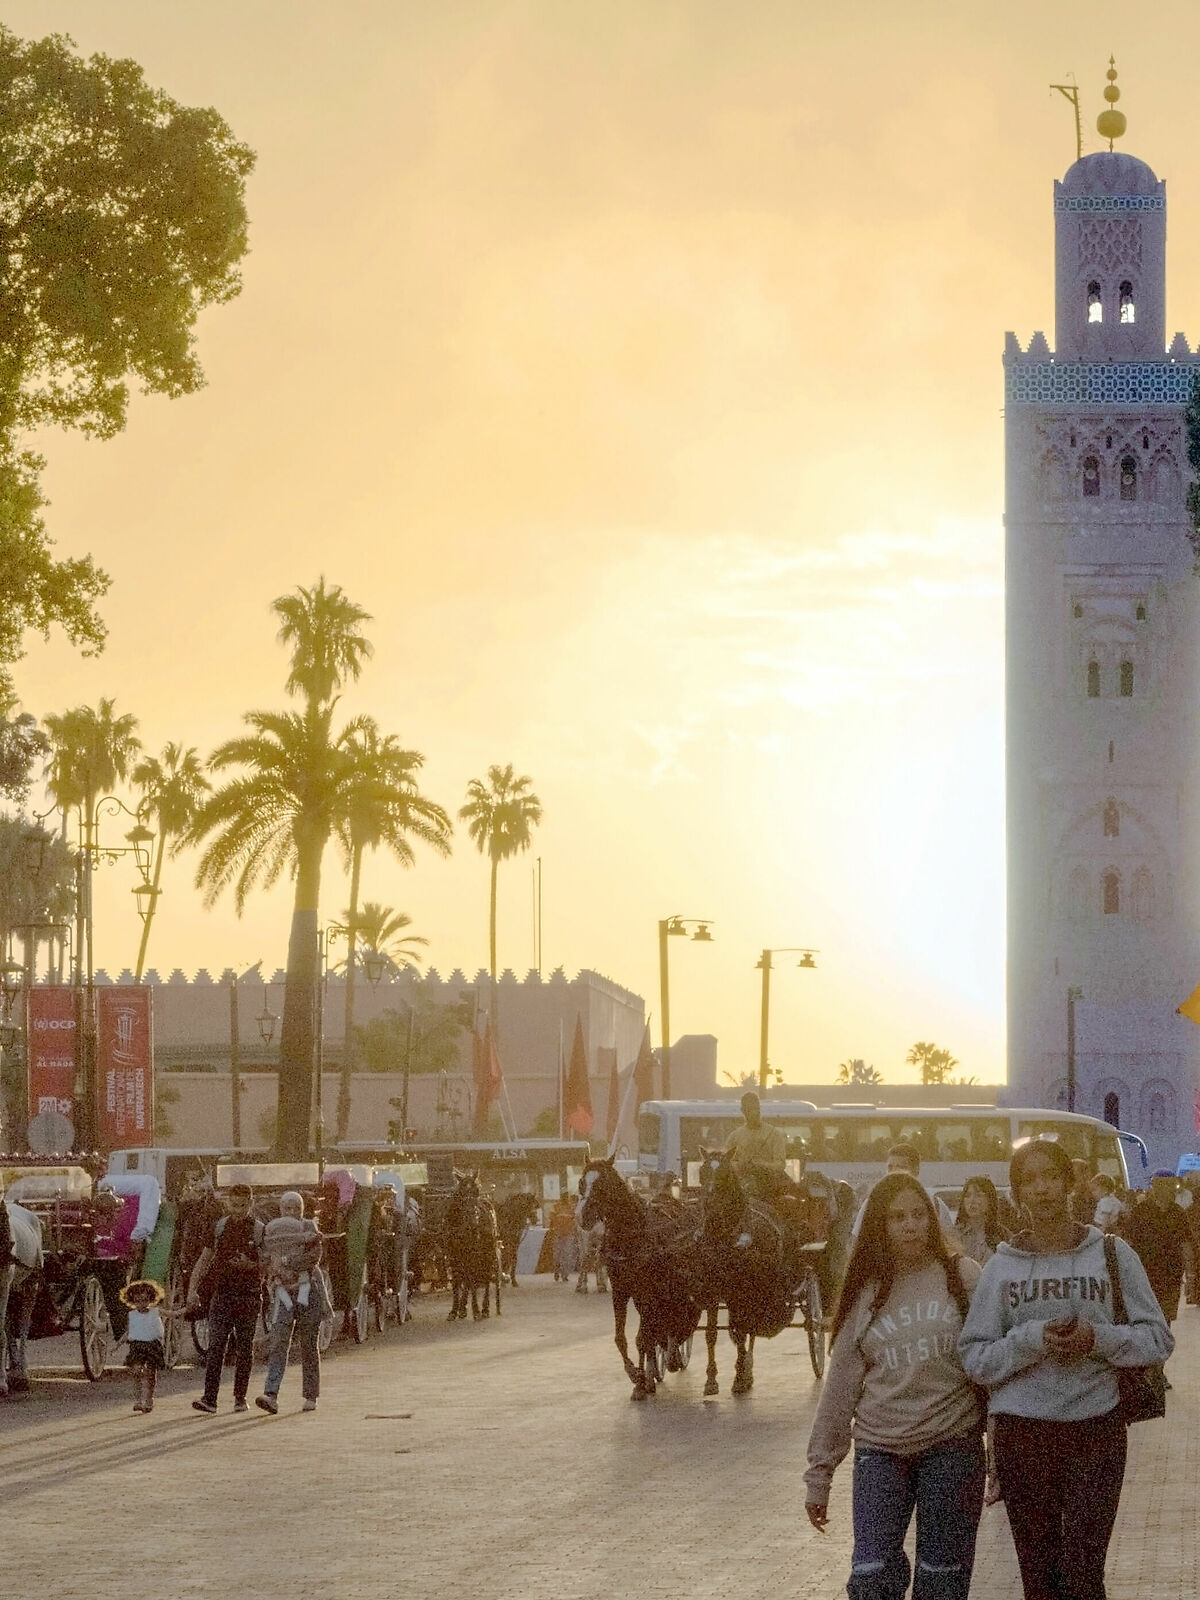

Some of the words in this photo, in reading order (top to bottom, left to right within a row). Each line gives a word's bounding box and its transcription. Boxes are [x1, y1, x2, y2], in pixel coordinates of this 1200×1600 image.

[49, 1020, 76, 1029] OCP
[492, 1148, 527, 1159] ALSA
[870, 1300, 956, 1341] INSIDE
